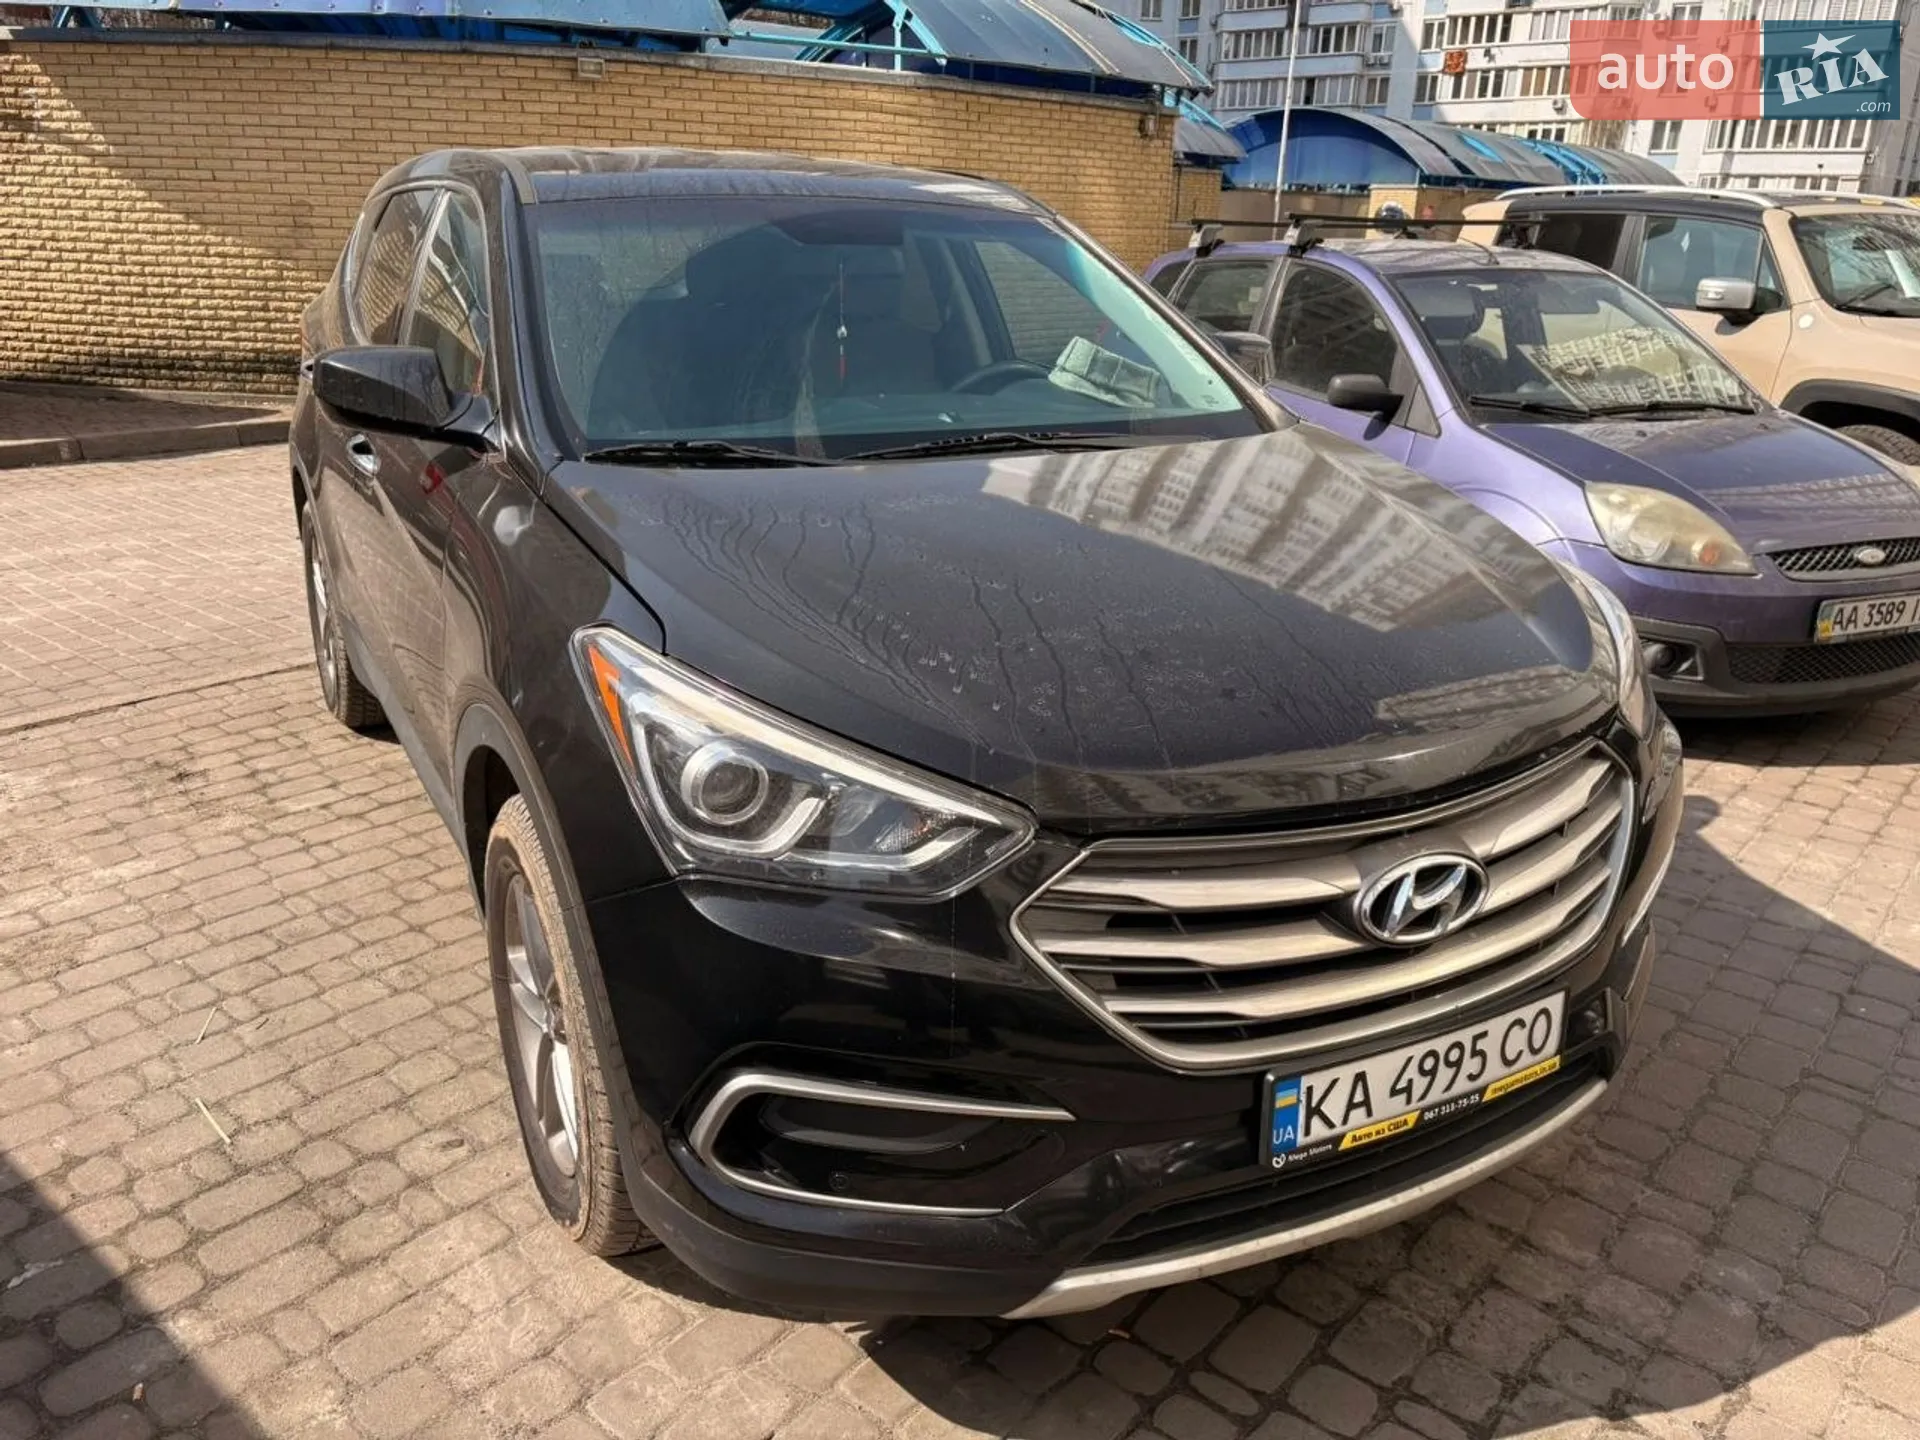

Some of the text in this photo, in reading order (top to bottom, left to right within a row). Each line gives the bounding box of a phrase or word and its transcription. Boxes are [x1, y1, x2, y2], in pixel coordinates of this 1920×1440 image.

[1832, 604, 1859, 631] AA
[1863, 600, 1907, 627] 3589
[1302, 1007, 1553, 1137] KA 4995 CO
[1272, 1125, 1295, 1144] UA
[1350, 1132, 1373, 1144] Авто
